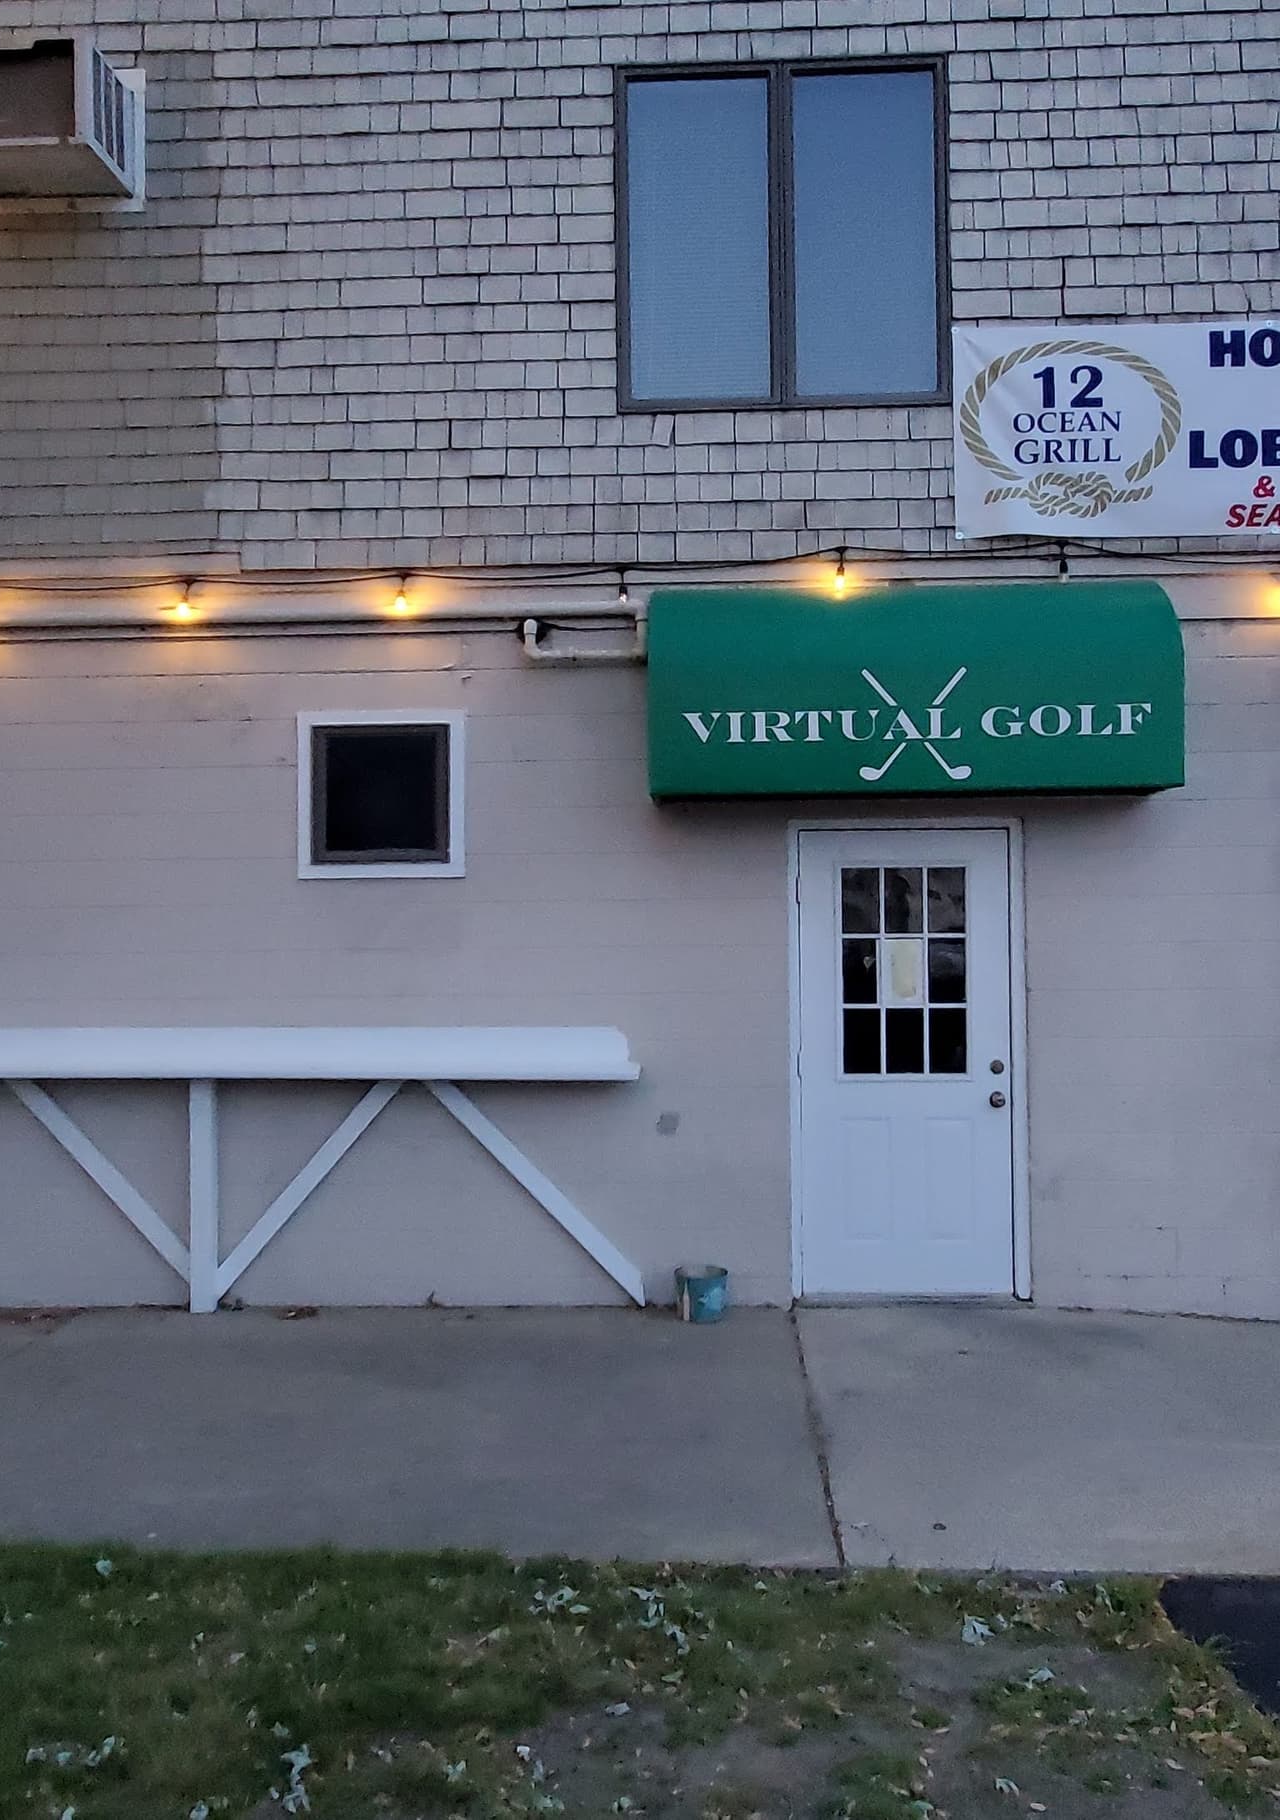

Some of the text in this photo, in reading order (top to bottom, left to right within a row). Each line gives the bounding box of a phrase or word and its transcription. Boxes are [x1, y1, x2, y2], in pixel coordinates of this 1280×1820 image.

[1033, 365, 1103, 408] 12
[1013, 411, 1121, 433] OCEAN
[1014, 438, 1121, 464] GRILL
[1253, 476, 1275, 497] &
[682, 703, 1152, 743] VIRTUAL GOLF
